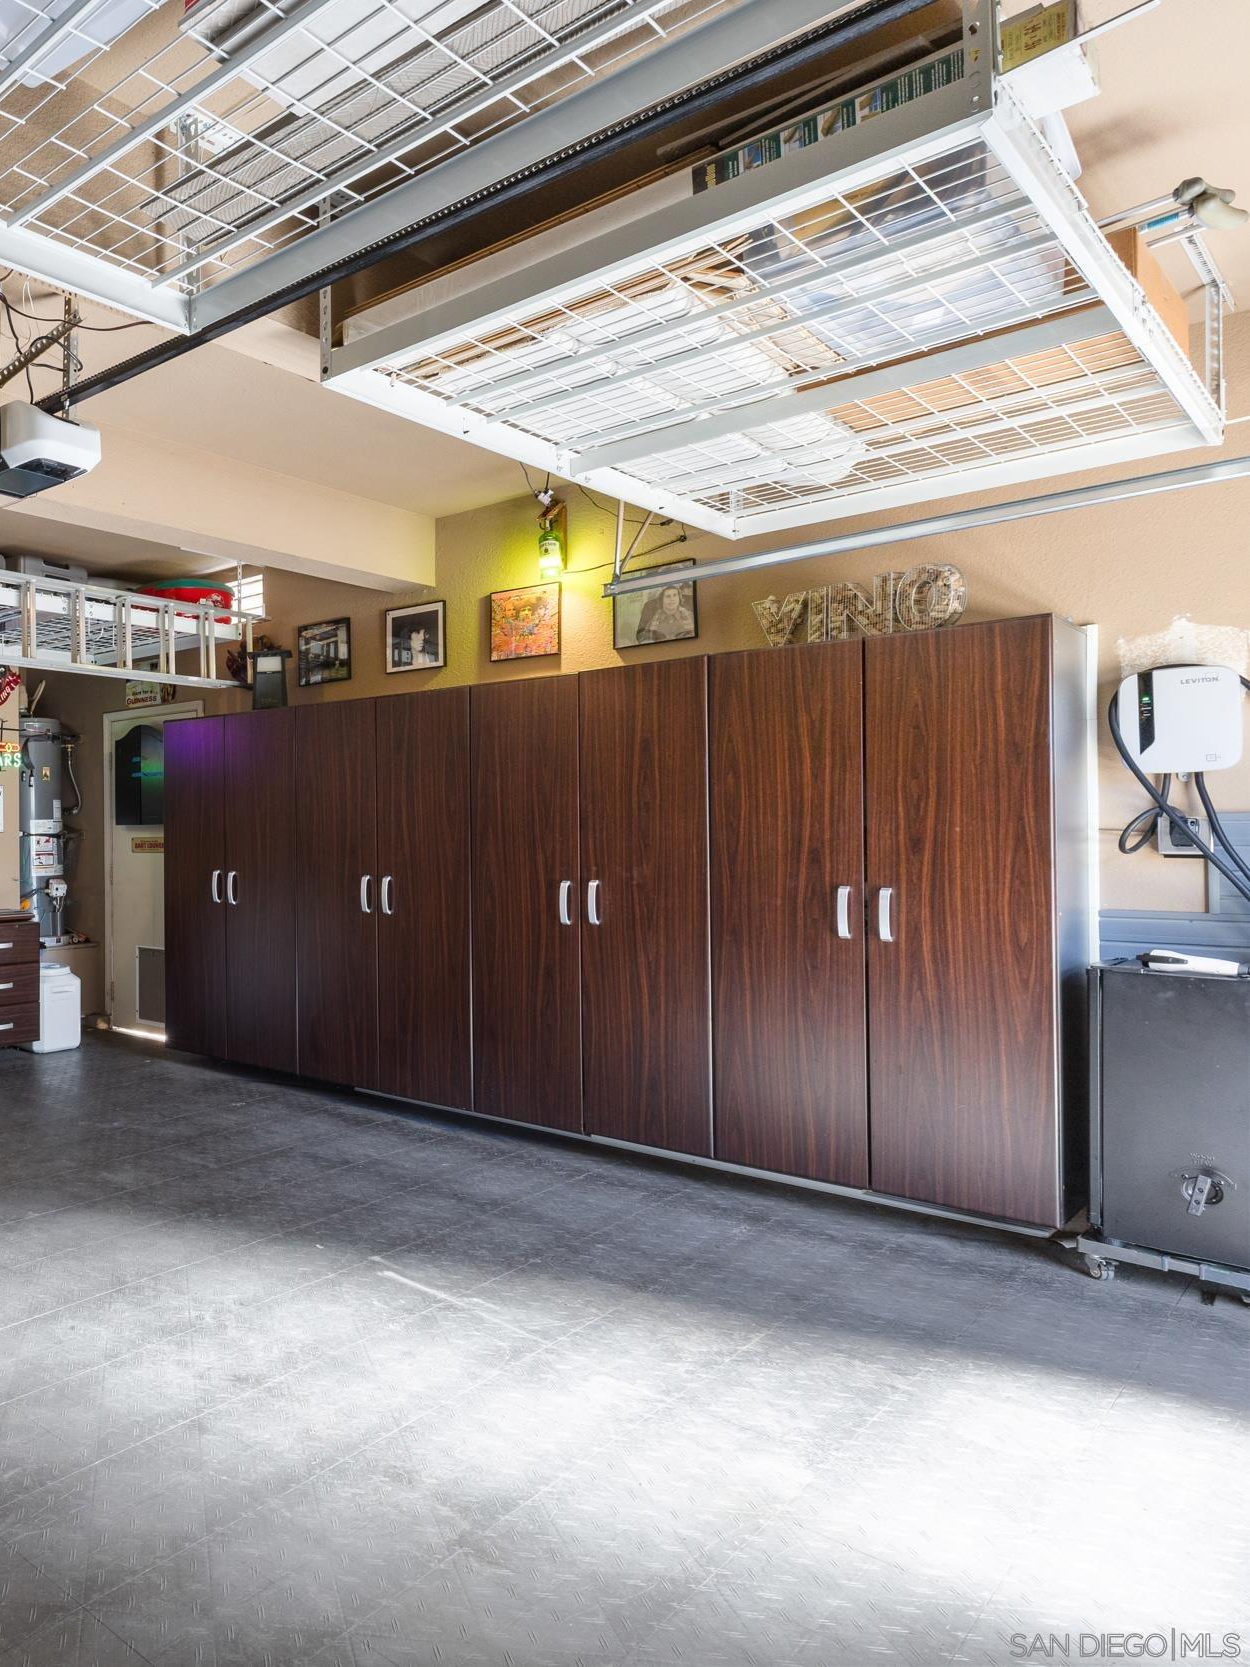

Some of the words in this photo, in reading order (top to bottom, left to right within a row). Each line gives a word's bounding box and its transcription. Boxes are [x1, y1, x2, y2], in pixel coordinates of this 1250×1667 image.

[751, 563, 967, 648] VINO
[1180, 676, 1219, 685] LEVITON
[126, 695, 158, 705] GUINNESS
